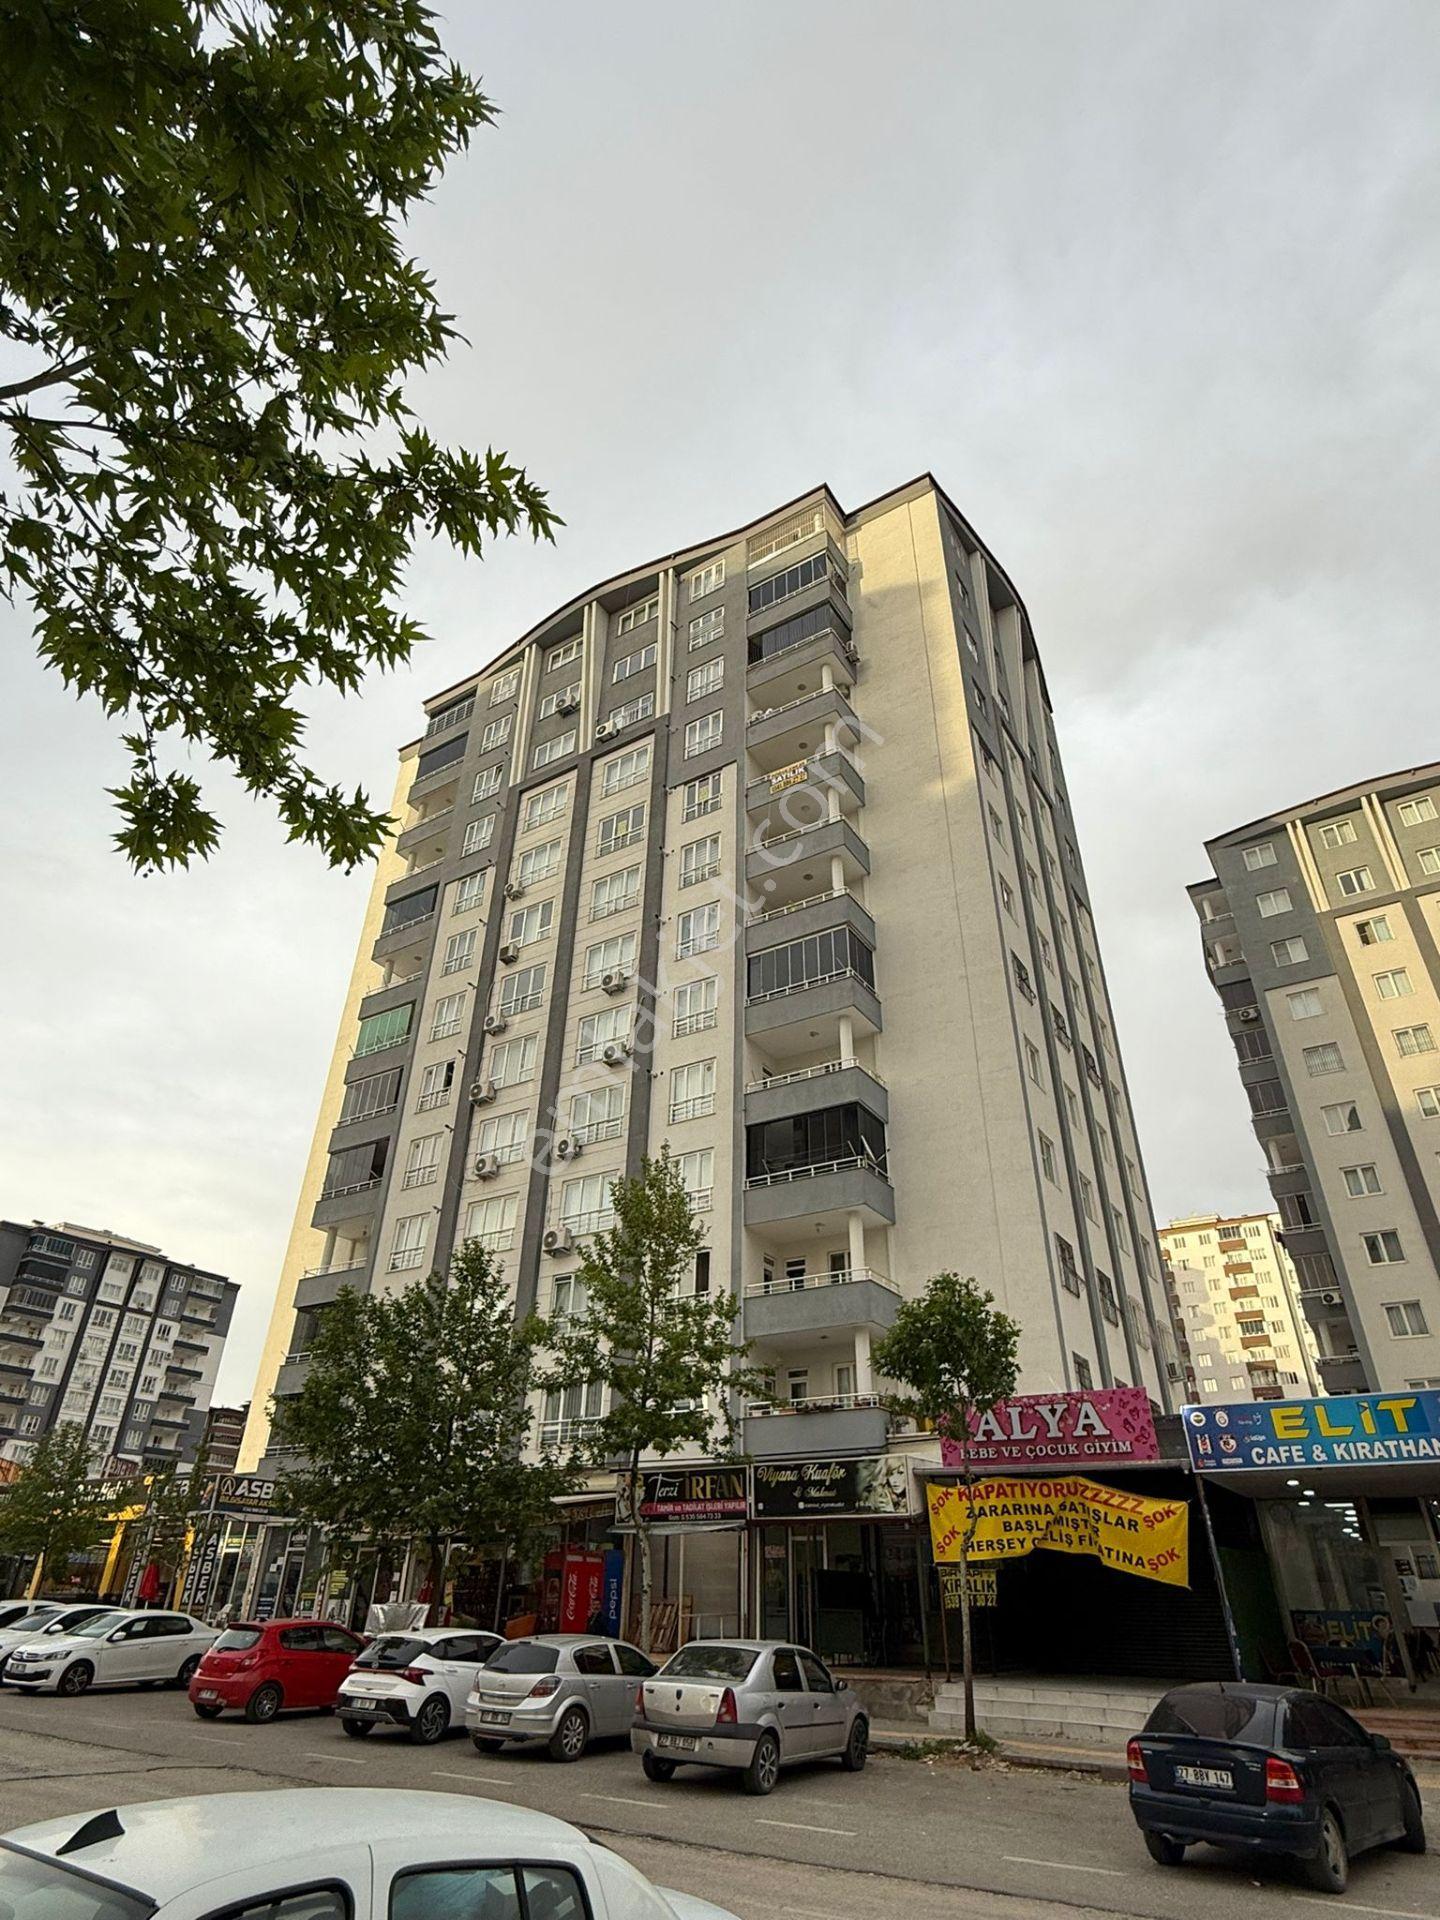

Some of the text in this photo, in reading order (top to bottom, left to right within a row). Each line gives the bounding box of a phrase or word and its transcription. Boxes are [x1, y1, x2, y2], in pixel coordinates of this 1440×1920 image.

[974, 1402, 1111, 1442] ALYA
[1269, 1398, 1417, 1440] ELİT
[1003, 1446, 1022, 1458] VE
[1026, 1443, 1079, 1460] ÇOCUK
[1083, 1438, 1133, 1454] GİYİM
[1250, 1444, 1306, 1465] CAFE
[1311, 1443, 1328, 1462] &
[648, 1470, 744, 1506] Terzi İRFAN
[757, 1462, 847, 1487] Viyana Kuaför
[234, 1479, 282, 1500] ASB
[931, 1488, 954, 1516] ŞOK
[965, 1503, 1055, 1519] ZARARINA
[1143, 1503, 1178, 1531] ŞOK
[936, 1525, 961, 1556] ŞOK
[1003, 1515, 1100, 1538] BAŞLAMIŞTR
[966, 1537, 1026, 1553] HERŞEY
[1078, 1533, 1145, 1569] FİATINA
[1147, 1547, 1182, 1574] ŞOK
[194, 1532, 217, 1604] ASBEK
[608, 1578, 618, 1619] pepsi
[1178, 1767, 1189, 1779] 27
[1213, 1771, 1230, 1784] 147
